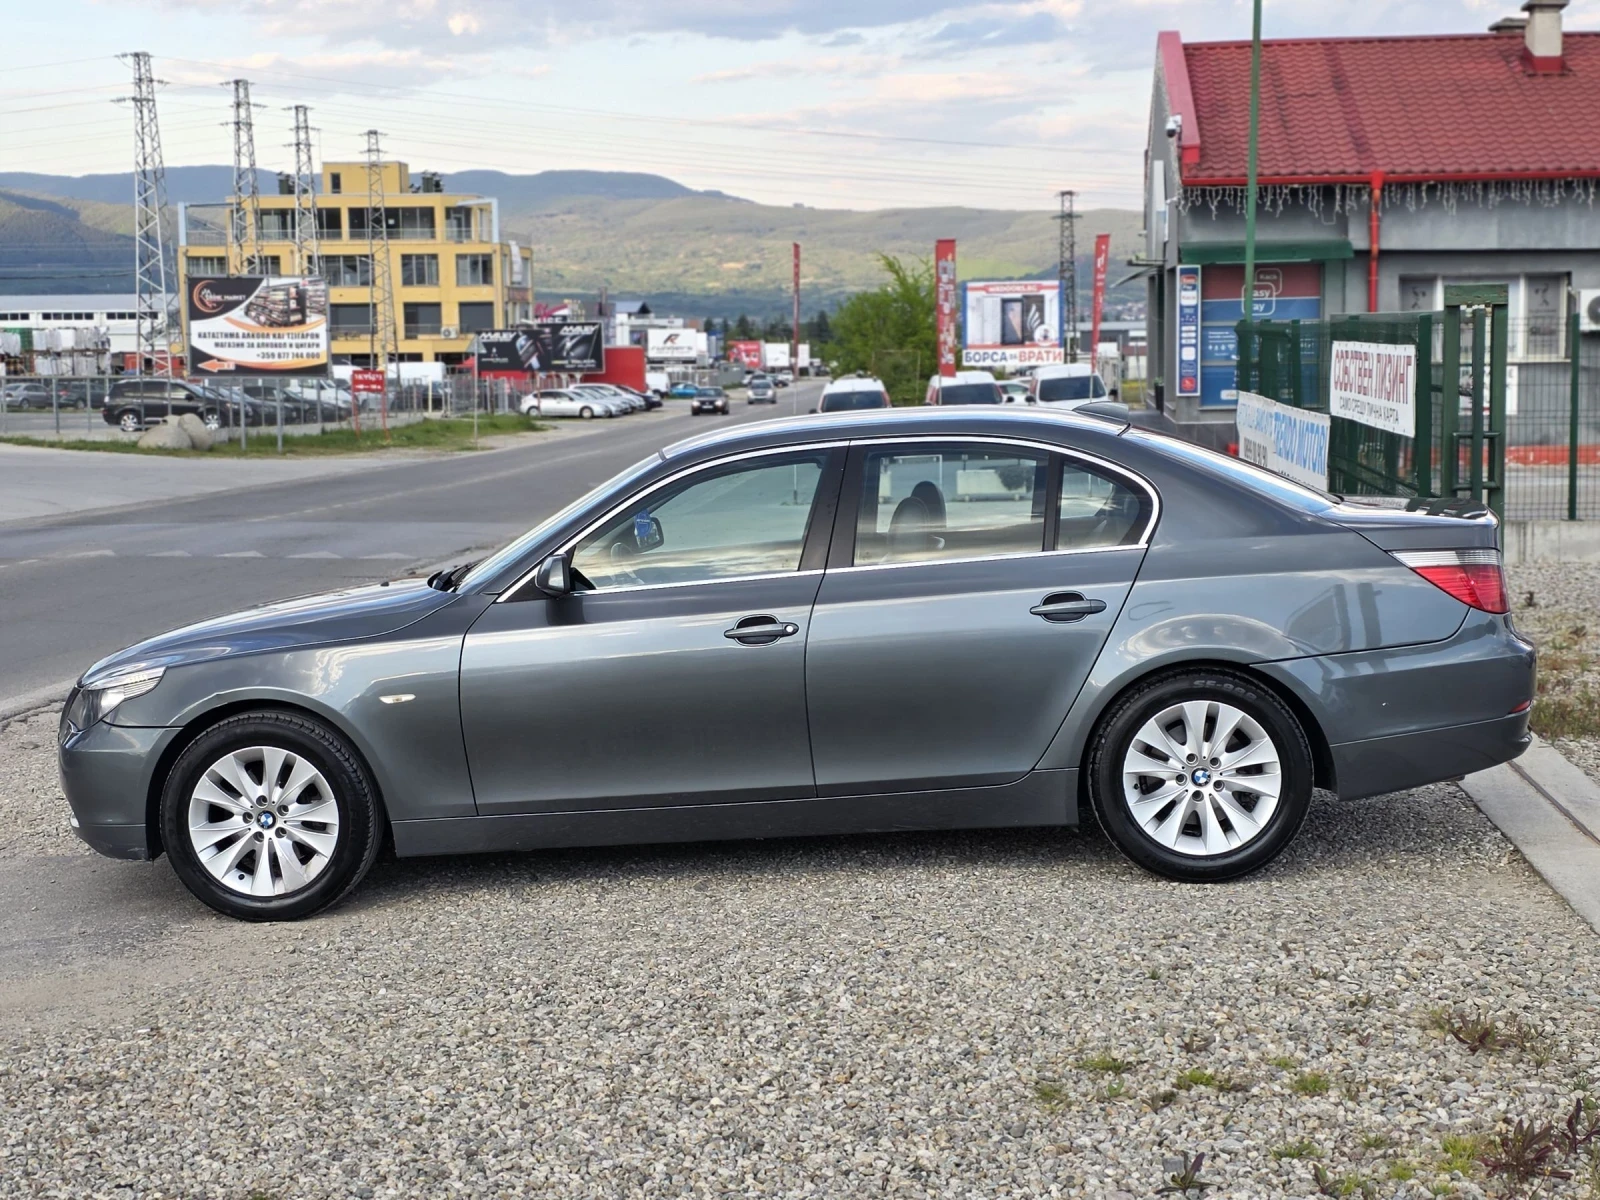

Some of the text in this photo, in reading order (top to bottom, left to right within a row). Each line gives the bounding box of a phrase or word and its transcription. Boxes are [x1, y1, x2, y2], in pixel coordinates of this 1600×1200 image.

[1252, 288, 1271, 298] asy
[1252, 302, 1265, 312] ay
[965, 351, 1008, 362] БОРСА
[1018, 350, 1063, 362] ВРАТИ
[1334, 349, 1373, 397] СОБСТВЕН
[1375, 353, 1412, 404] ЛИЗИНГ
